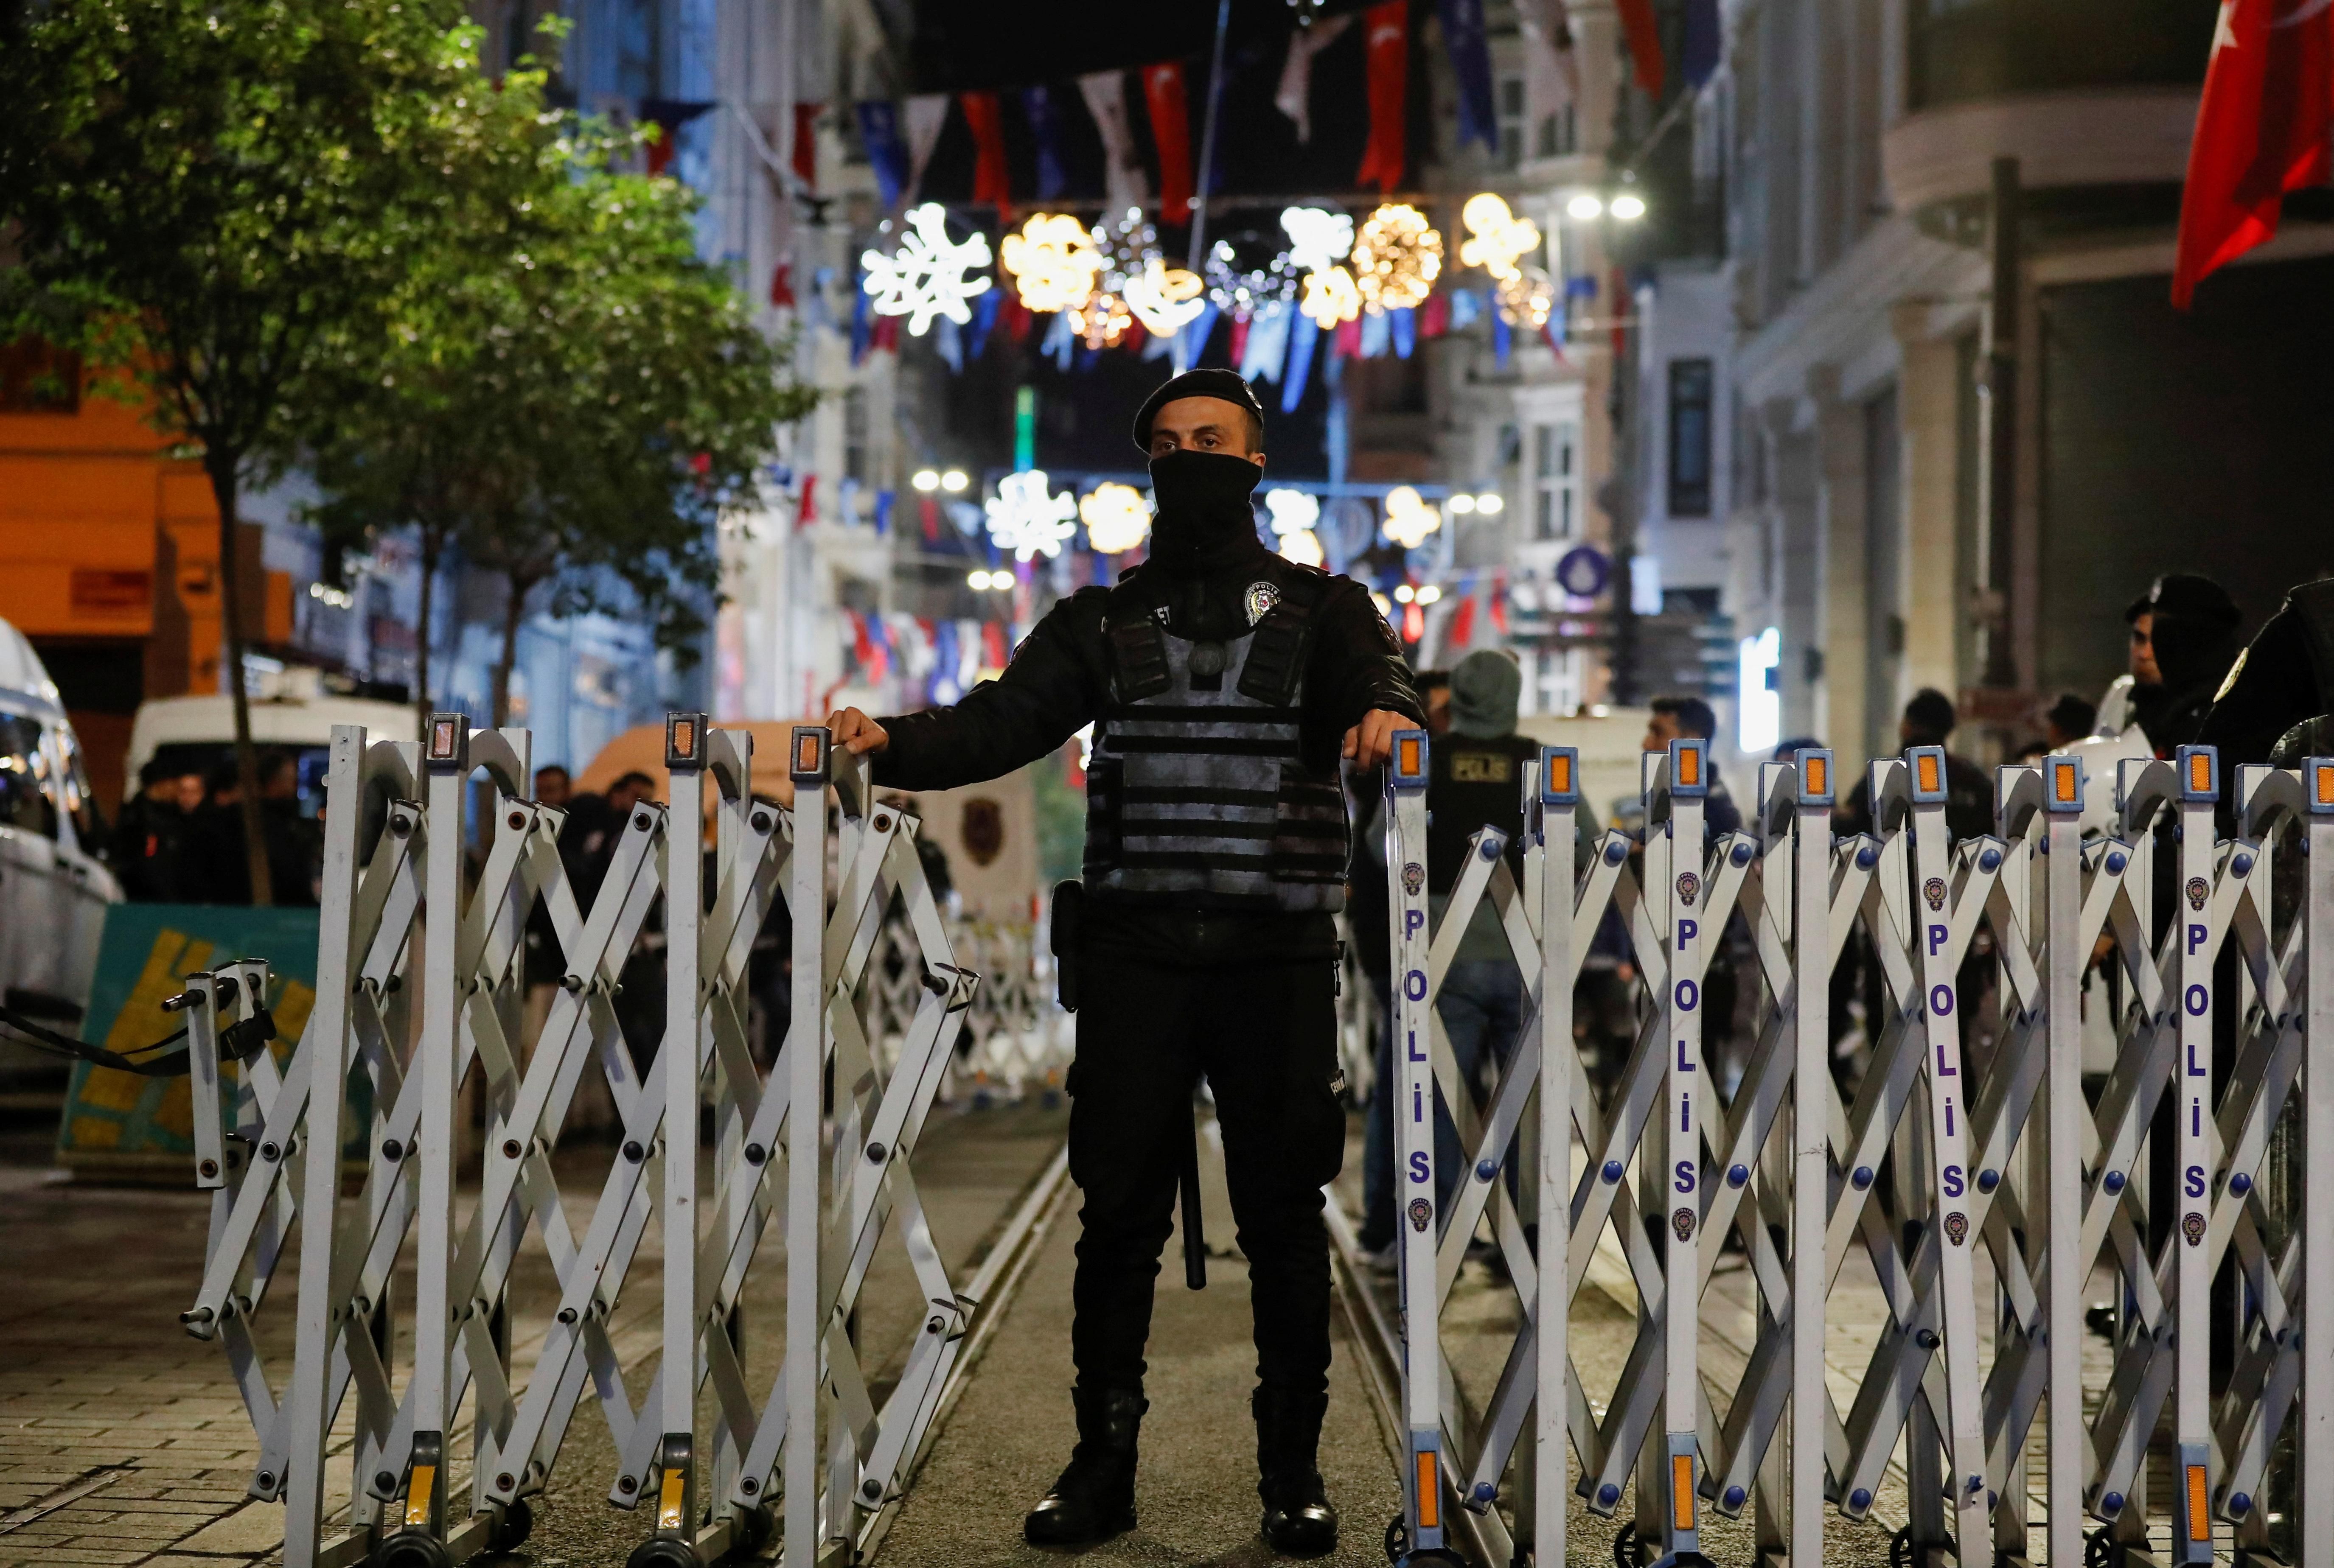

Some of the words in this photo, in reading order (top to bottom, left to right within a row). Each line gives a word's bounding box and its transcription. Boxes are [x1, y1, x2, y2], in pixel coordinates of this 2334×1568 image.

[1404, 910, 1430, 1184] POLİS
[1675, 920, 1698, 1193] POLİS
[1929, 924, 1964, 1197] POLİS
[2185, 924, 2208, 1197] POLİS
